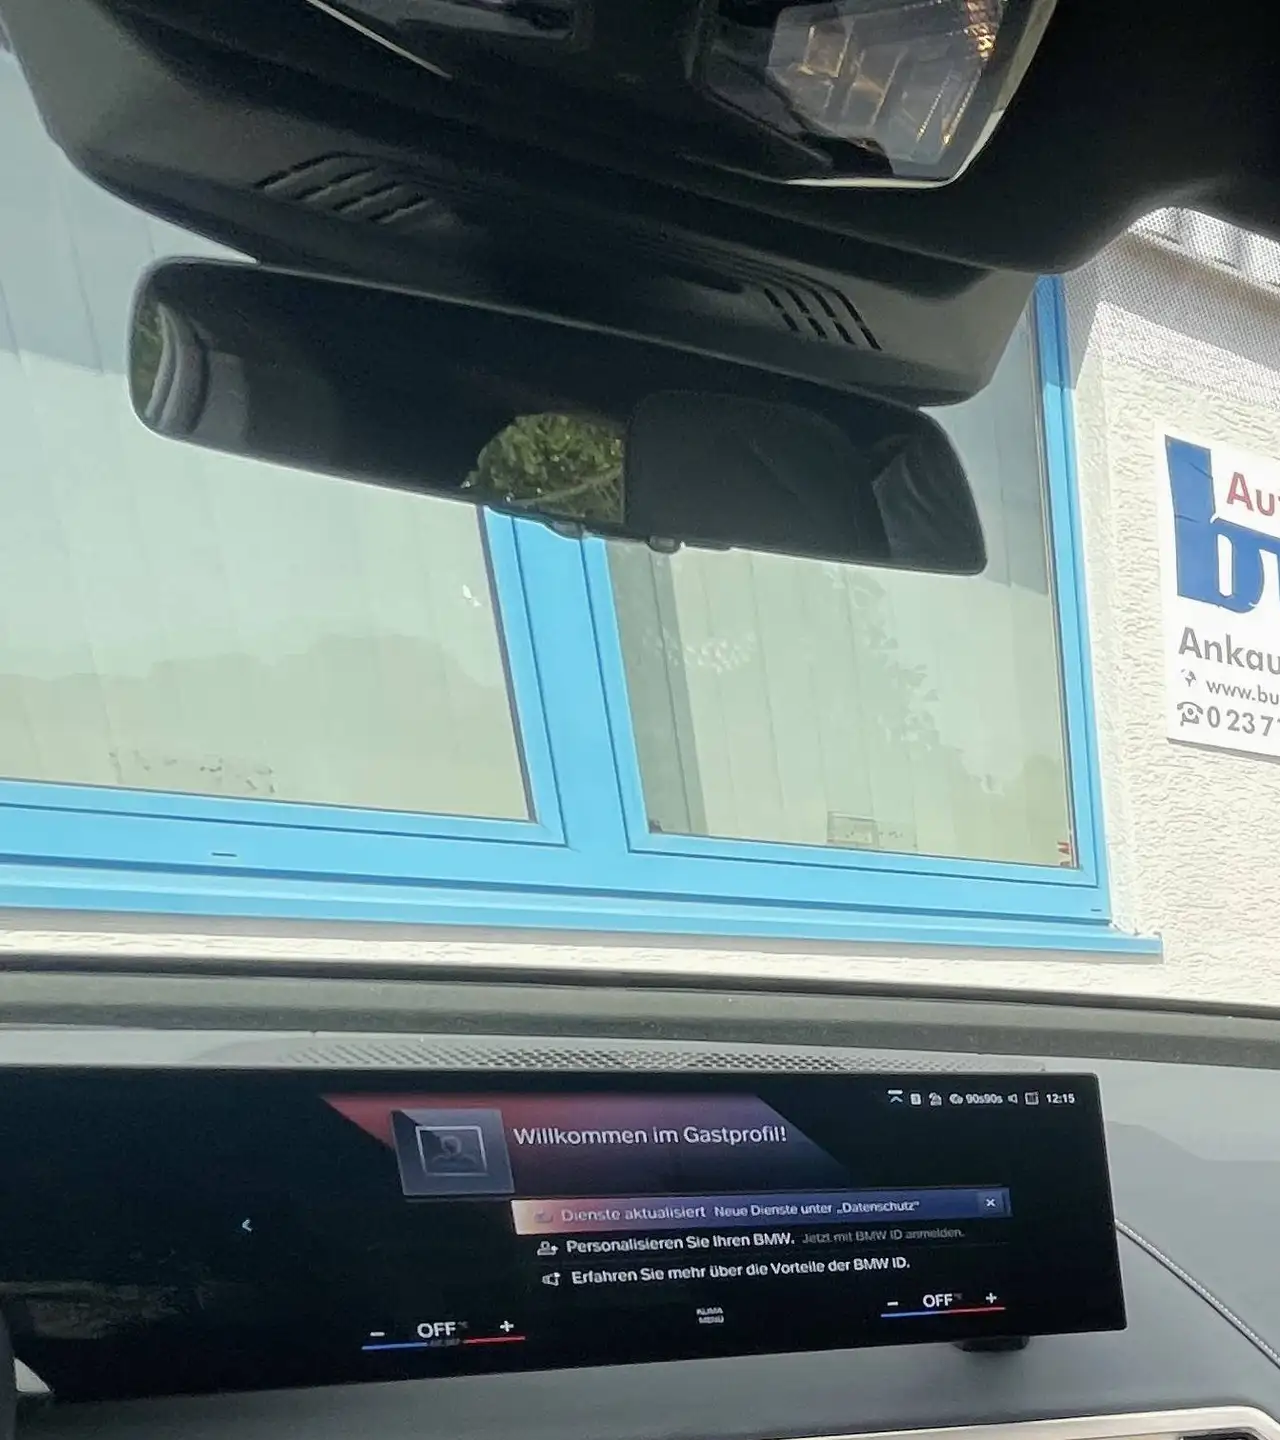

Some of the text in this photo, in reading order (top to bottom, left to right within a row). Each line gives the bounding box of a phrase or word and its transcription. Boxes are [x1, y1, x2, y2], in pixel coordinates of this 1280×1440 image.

[1046, 1093, 1075, 1104] 12:15
[513, 1125, 787, 1147] Willkommen im Gastprofil!
[561, 1208, 621, 1223] Dienste
[625, 1206, 706, 1221] aktualisiert
[714, 1206, 747, 1218] Neue
[751, 1204, 797, 1217] Dienste
[801, 1203, 832, 1215] unter
[566, 1235, 684, 1254] Personalisieren
[687, 1234, 710, 1249] Sie
[713, 1233, 750, 1248] Ihren
[753, 1232, 795, 1246] BMW.
[855, 1229, 887, 1242] BMW
[890, 1228, 903, 1241] ID
[572, 1256, 910, 1285] Erfahren Sie mehr über die Vorteile der BMW ID.
[923, 1293, 953, 1308] OFF
[417, 1321, 457, 1340] OFF
